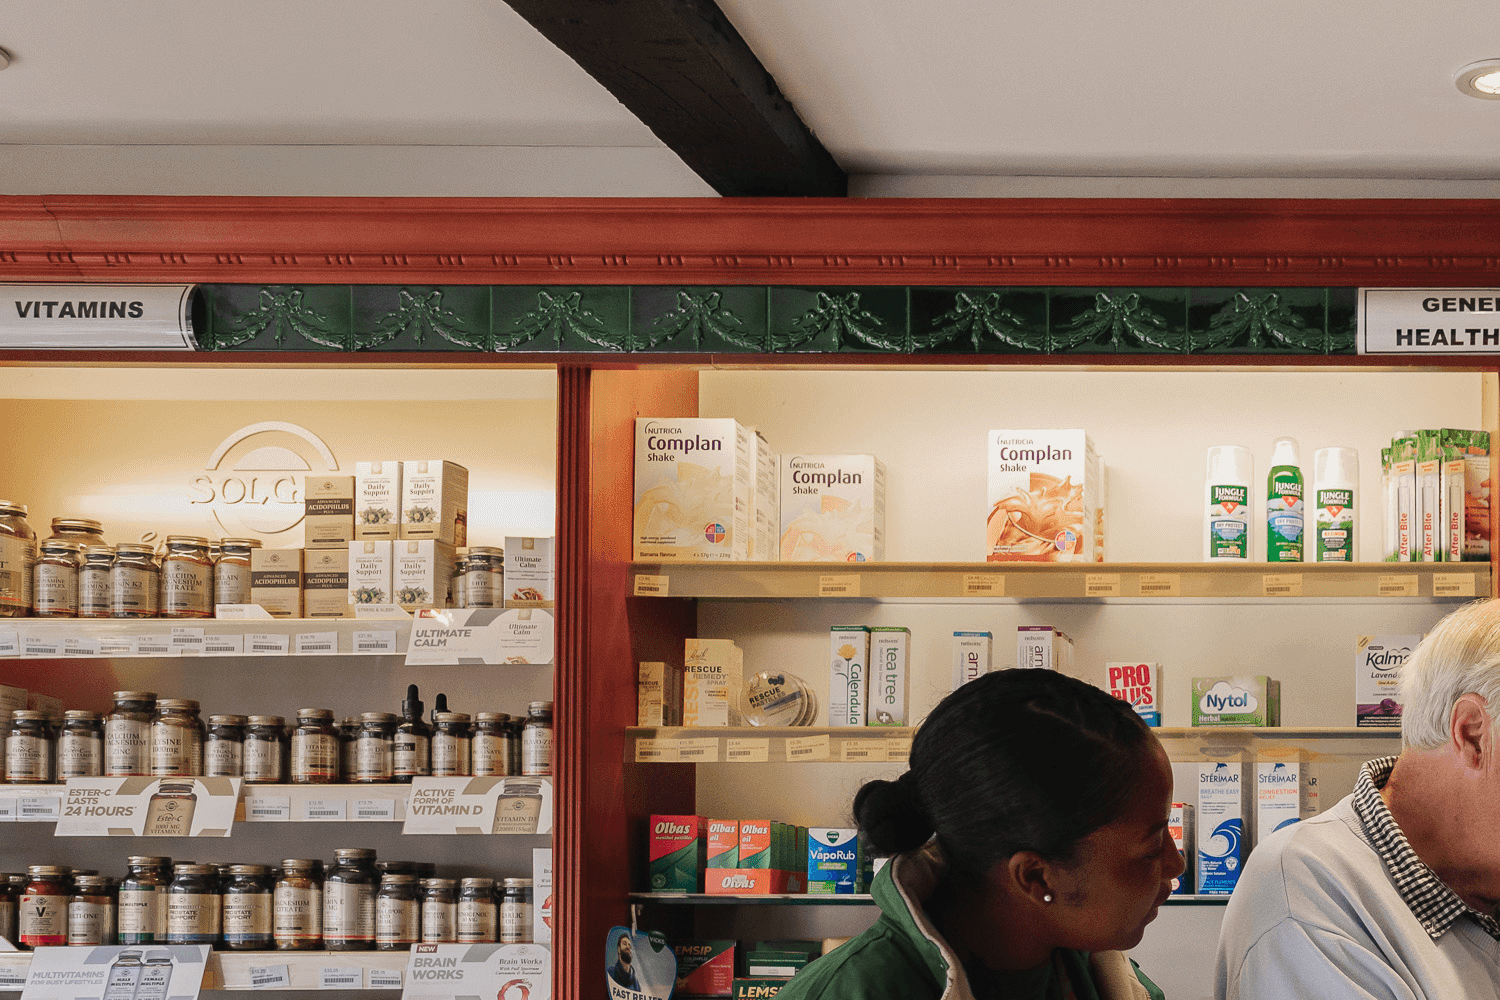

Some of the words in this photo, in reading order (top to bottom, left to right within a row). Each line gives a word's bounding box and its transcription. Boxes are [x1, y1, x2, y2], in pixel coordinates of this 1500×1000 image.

[15, 301, 143, 319] VITAMINS
[647, 435, 722, 454] Complan
[648, 453, 675, 462] Shake
[1000, 445, 1072, 464] Complan
[1000, 463, 1027, 472] Shake
[793, 469, 862, 487] Complan
[367, 483, 385, 491] Daily
[1214, 487, 1245, 498] JUNGLE
[1275, 482, 1302, 492] JUNGLE
[1400, 512, 1408, 532] Bite
[1400, 533, 1408, 556] After
[416, 629, 472, 637] ULTIMATE
[414, 639, 447, 647] CALM
[887, 647, 897, 668] tea
[1109, 664, 1151, 688] PRO
[850, 663, 861, 725] Calendula
[885, 674, 896, 705] tree
[1111, 686, 1153, 706] PLUS
[1206, 693, 1247, 711] Nytol
[1201, 773, 1239, 783] STÉRIMAR
[69, 789, 113, 797] ESTER-C
[415, 789, 455, 797] ACTIVE
[67, 797, 99, 805] LASTS
[412, 805, 469, 815] VITAMIN
[472, 805, 483, 815] D
[655, 822, 690, 834] Olbas
[810, 850, 856, 861] VapoRub
[413, 957, 457, 968] BRAIN
[32, 971, 105, 979] MULTIVITAMINS
[412, 970, 464, 980] WORKS
[612, 986, 633, 1000] FAST
